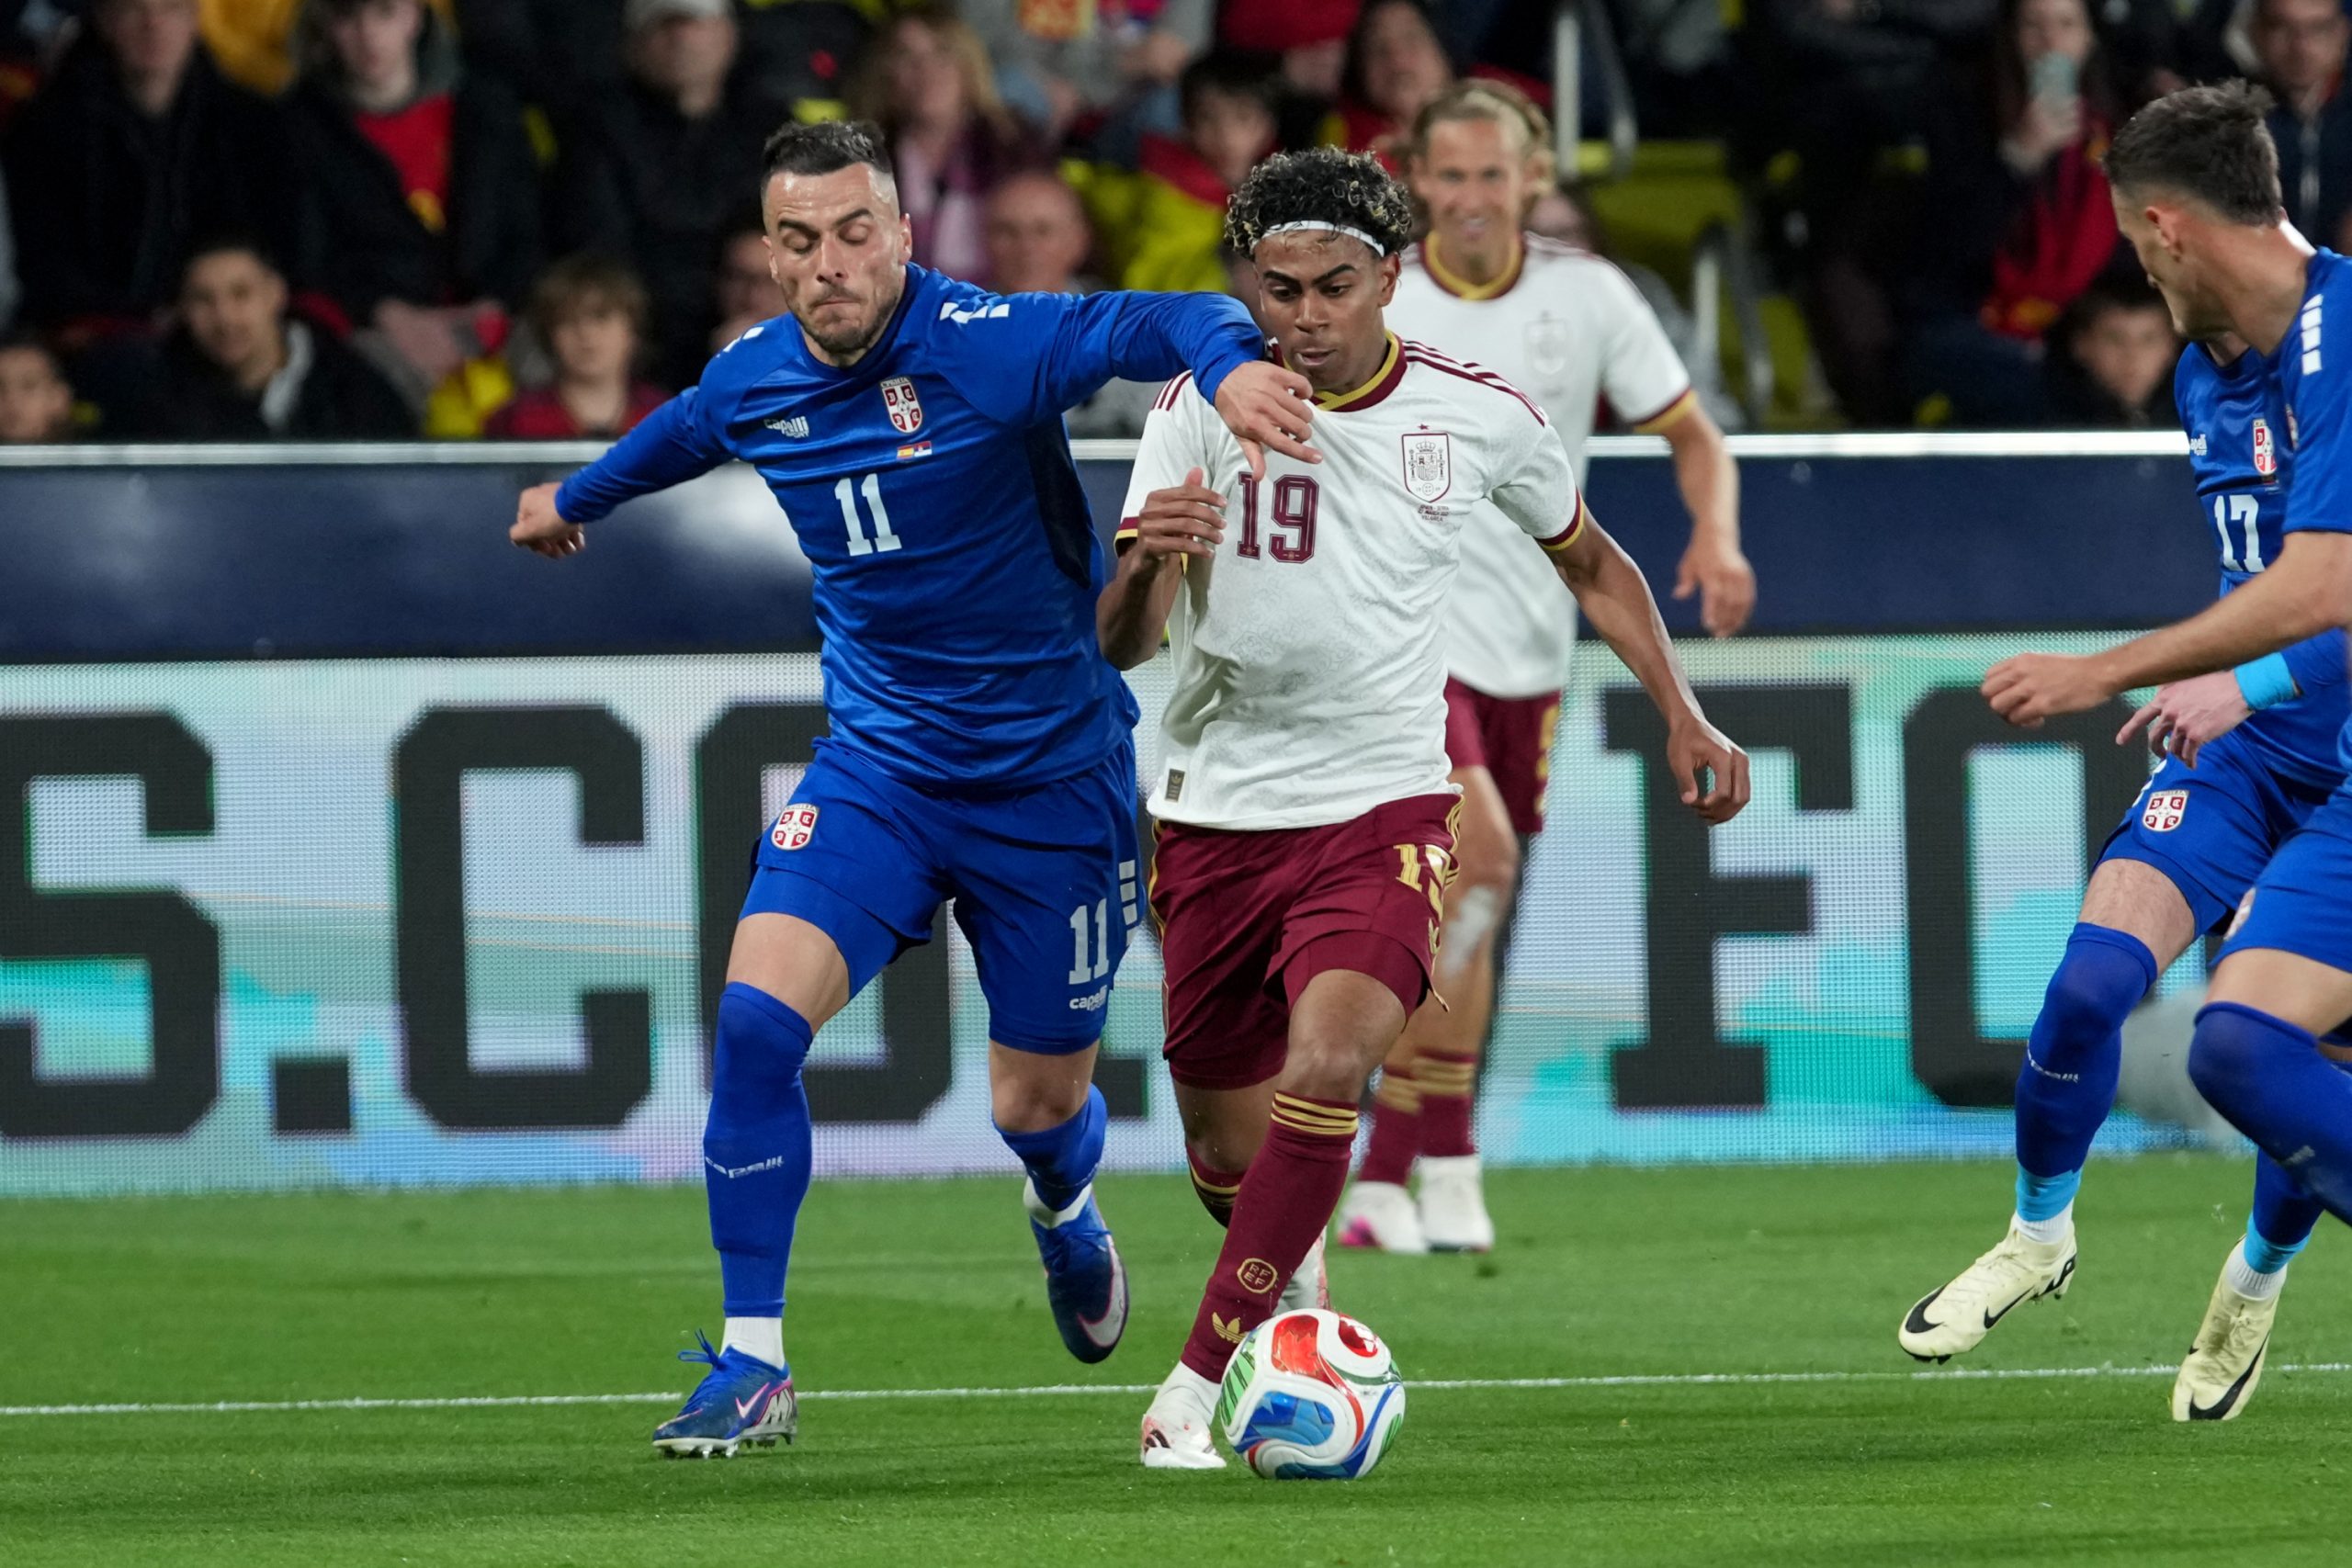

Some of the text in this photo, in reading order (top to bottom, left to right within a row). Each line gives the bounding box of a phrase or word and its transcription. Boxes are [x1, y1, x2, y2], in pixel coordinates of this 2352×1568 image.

[834, 473, 902, 557] 11
[1237, 470, 1320, 564] 19
[2213, 493, 2266, 573] 17
[1068, 897, 1110, 985] 11
